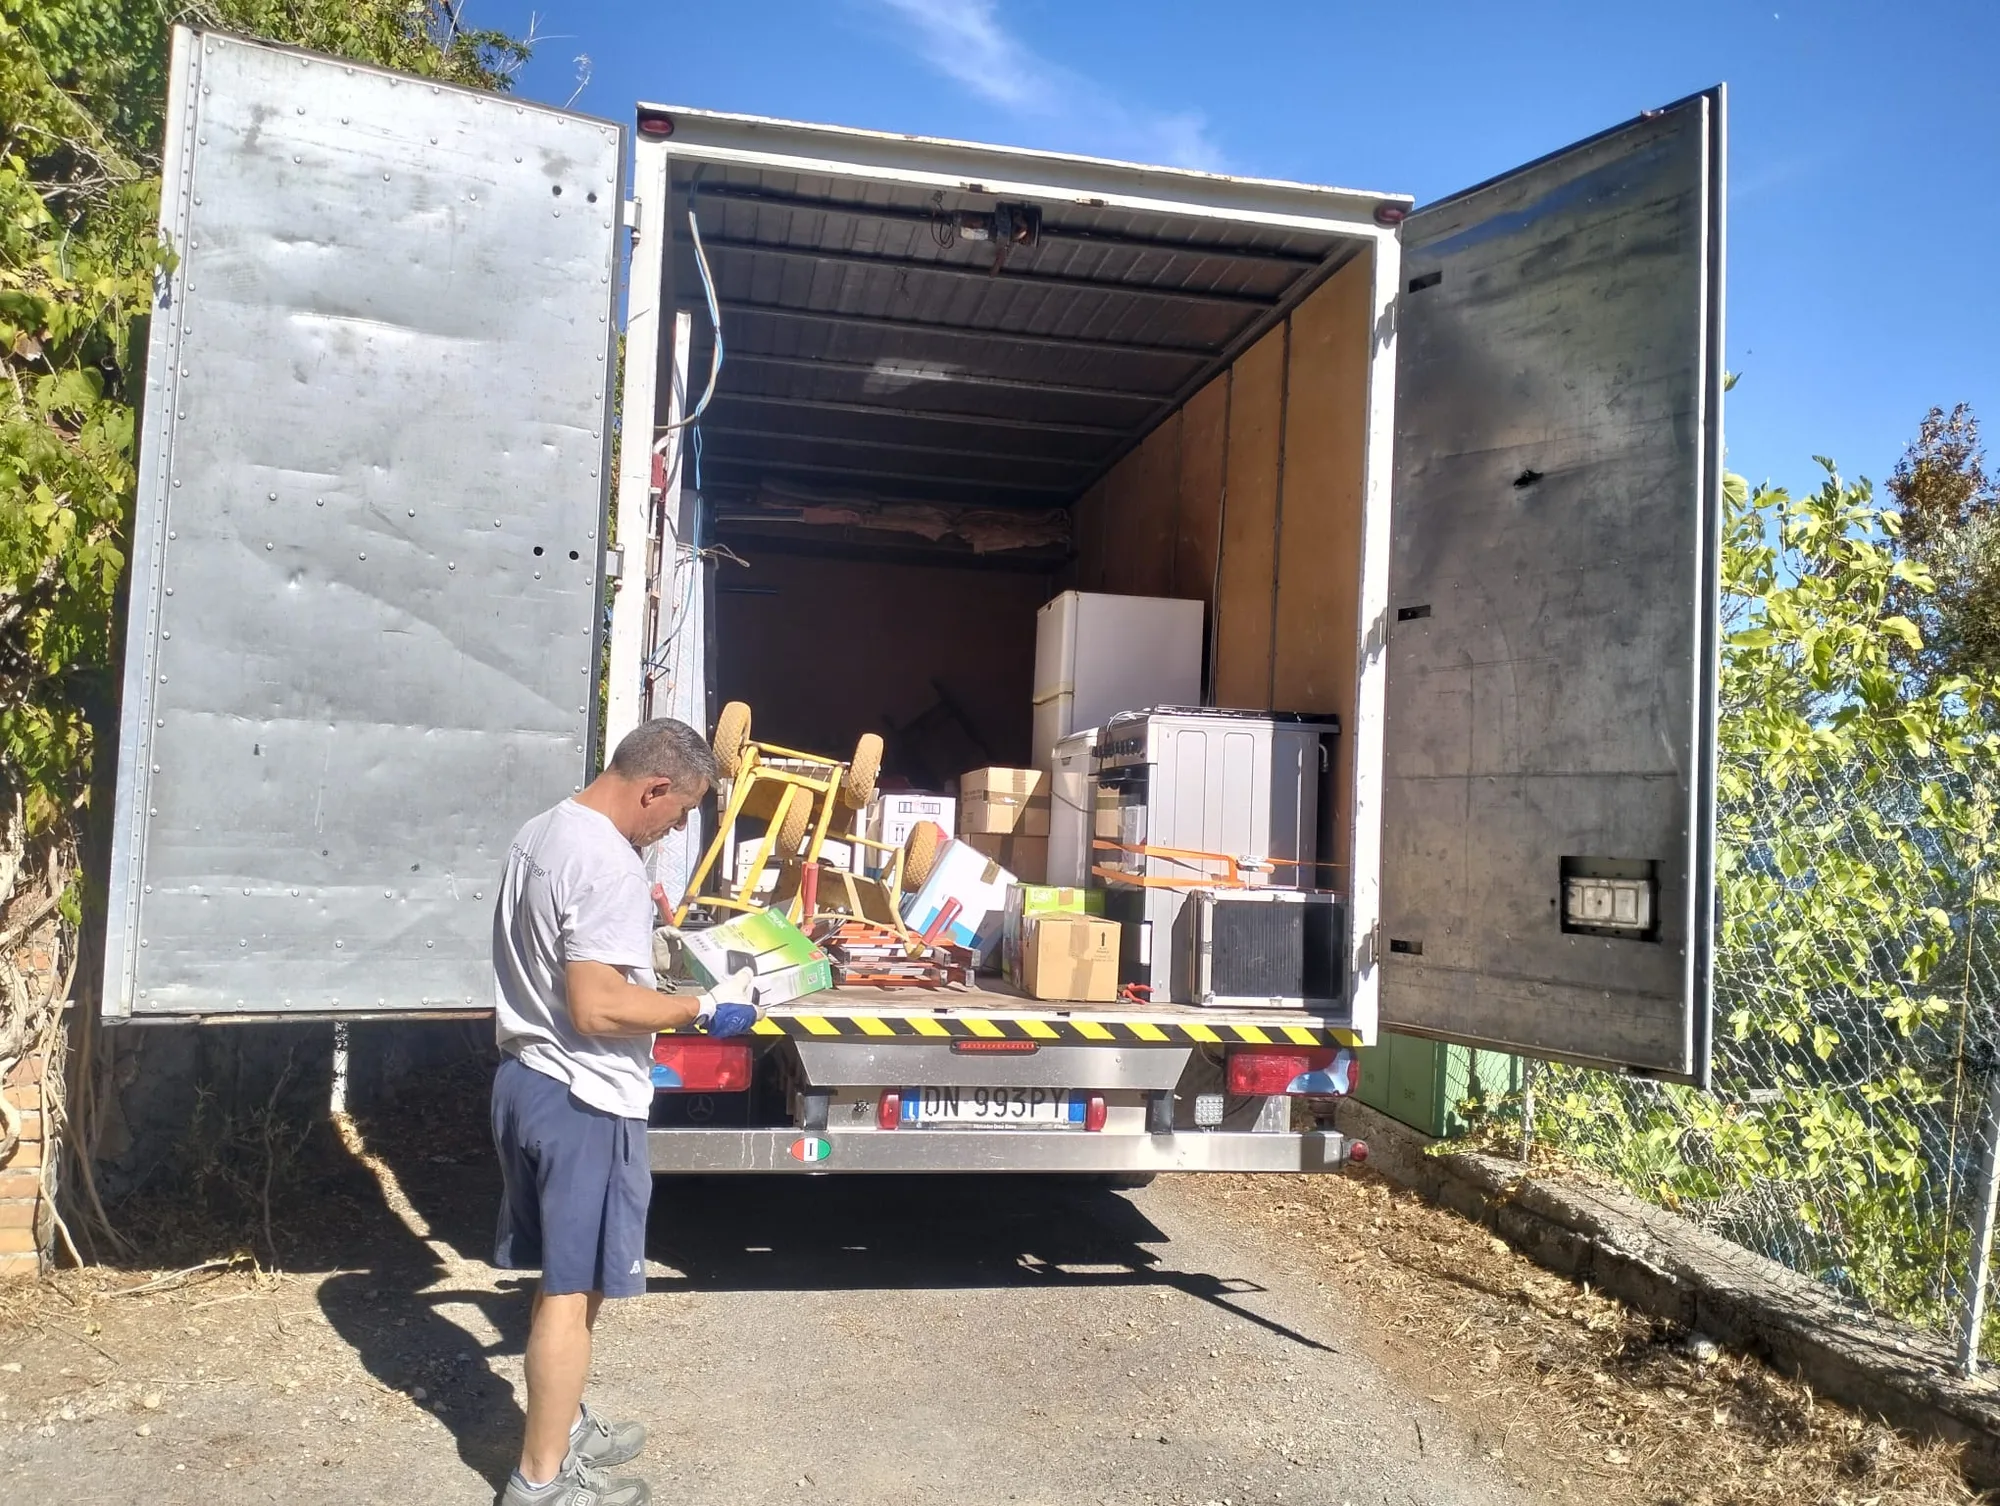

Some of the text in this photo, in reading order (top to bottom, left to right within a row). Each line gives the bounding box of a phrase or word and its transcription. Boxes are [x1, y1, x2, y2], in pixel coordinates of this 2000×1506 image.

[925, 1086, 1065, 1118] DN 993PY
[808, 1143, 813, 1157] I
